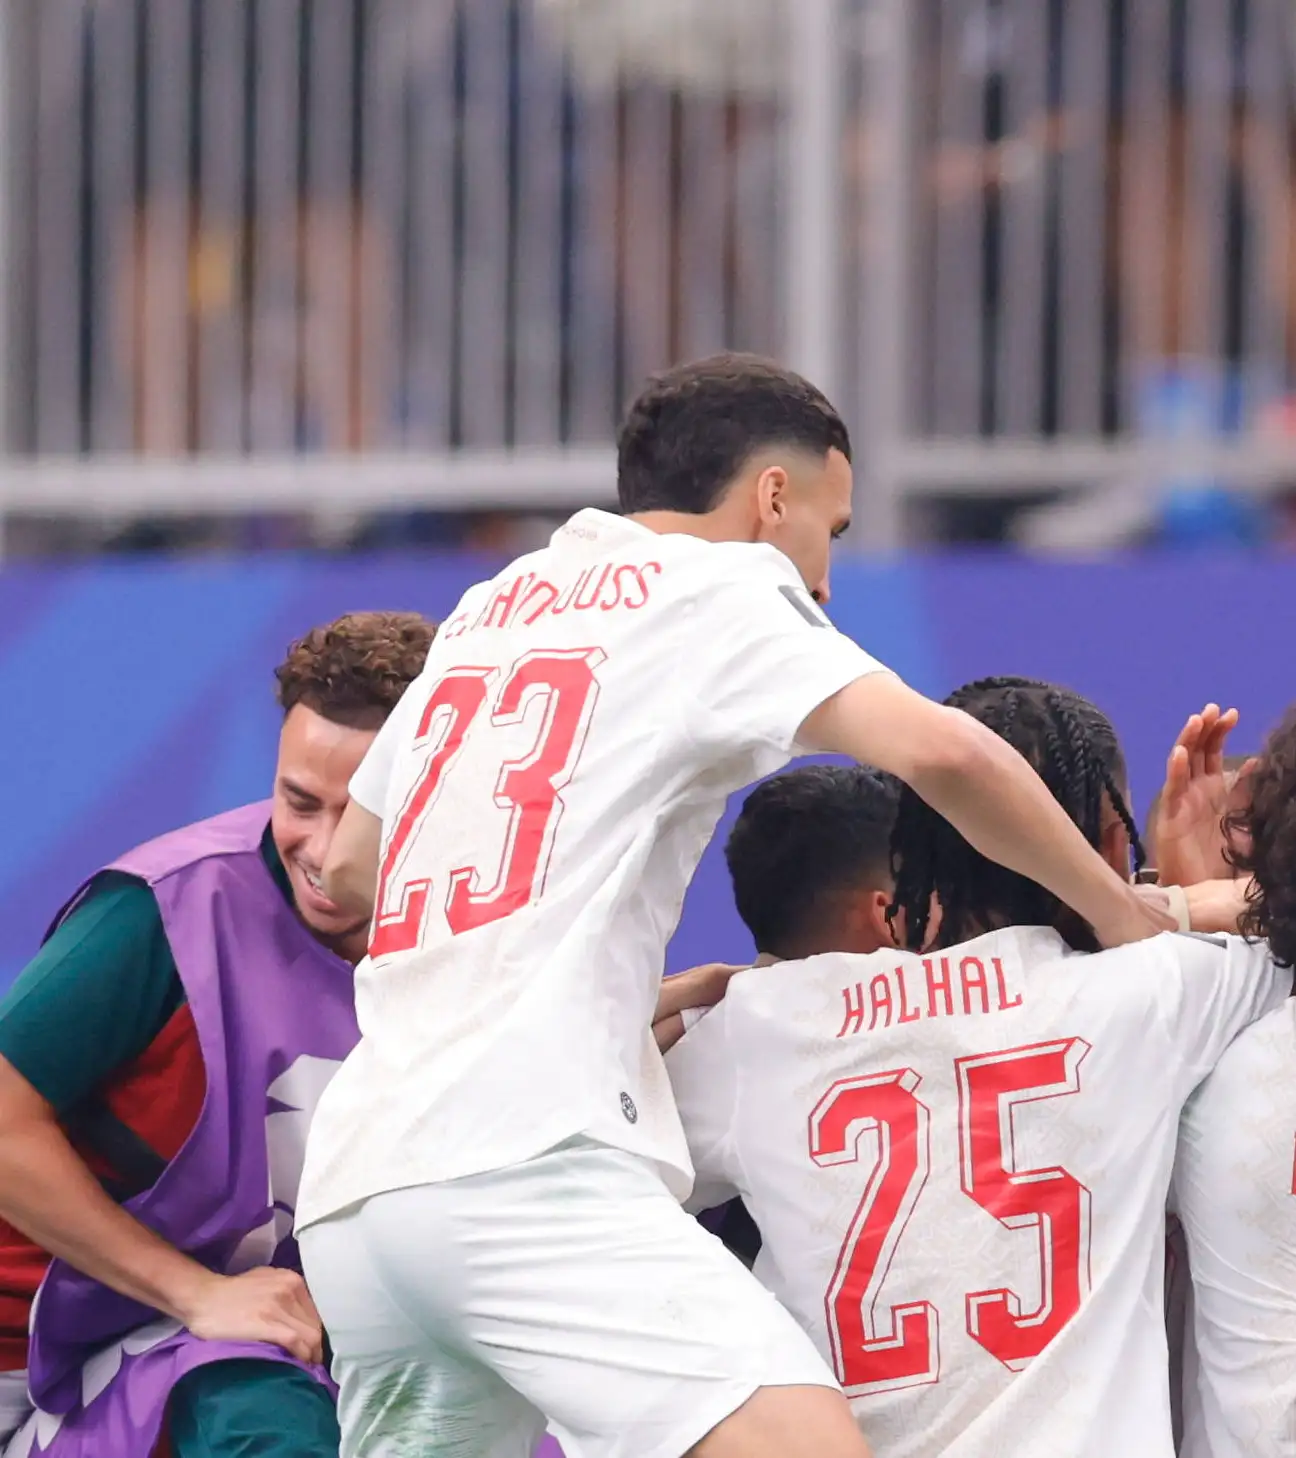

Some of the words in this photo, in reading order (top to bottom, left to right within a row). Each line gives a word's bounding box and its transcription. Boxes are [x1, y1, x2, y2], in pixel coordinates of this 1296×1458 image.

[369, 646, 608, 962] 23
[837, 957, 1023, 1037] HALHAL
[808, 1036, 1092, 1398] 25
